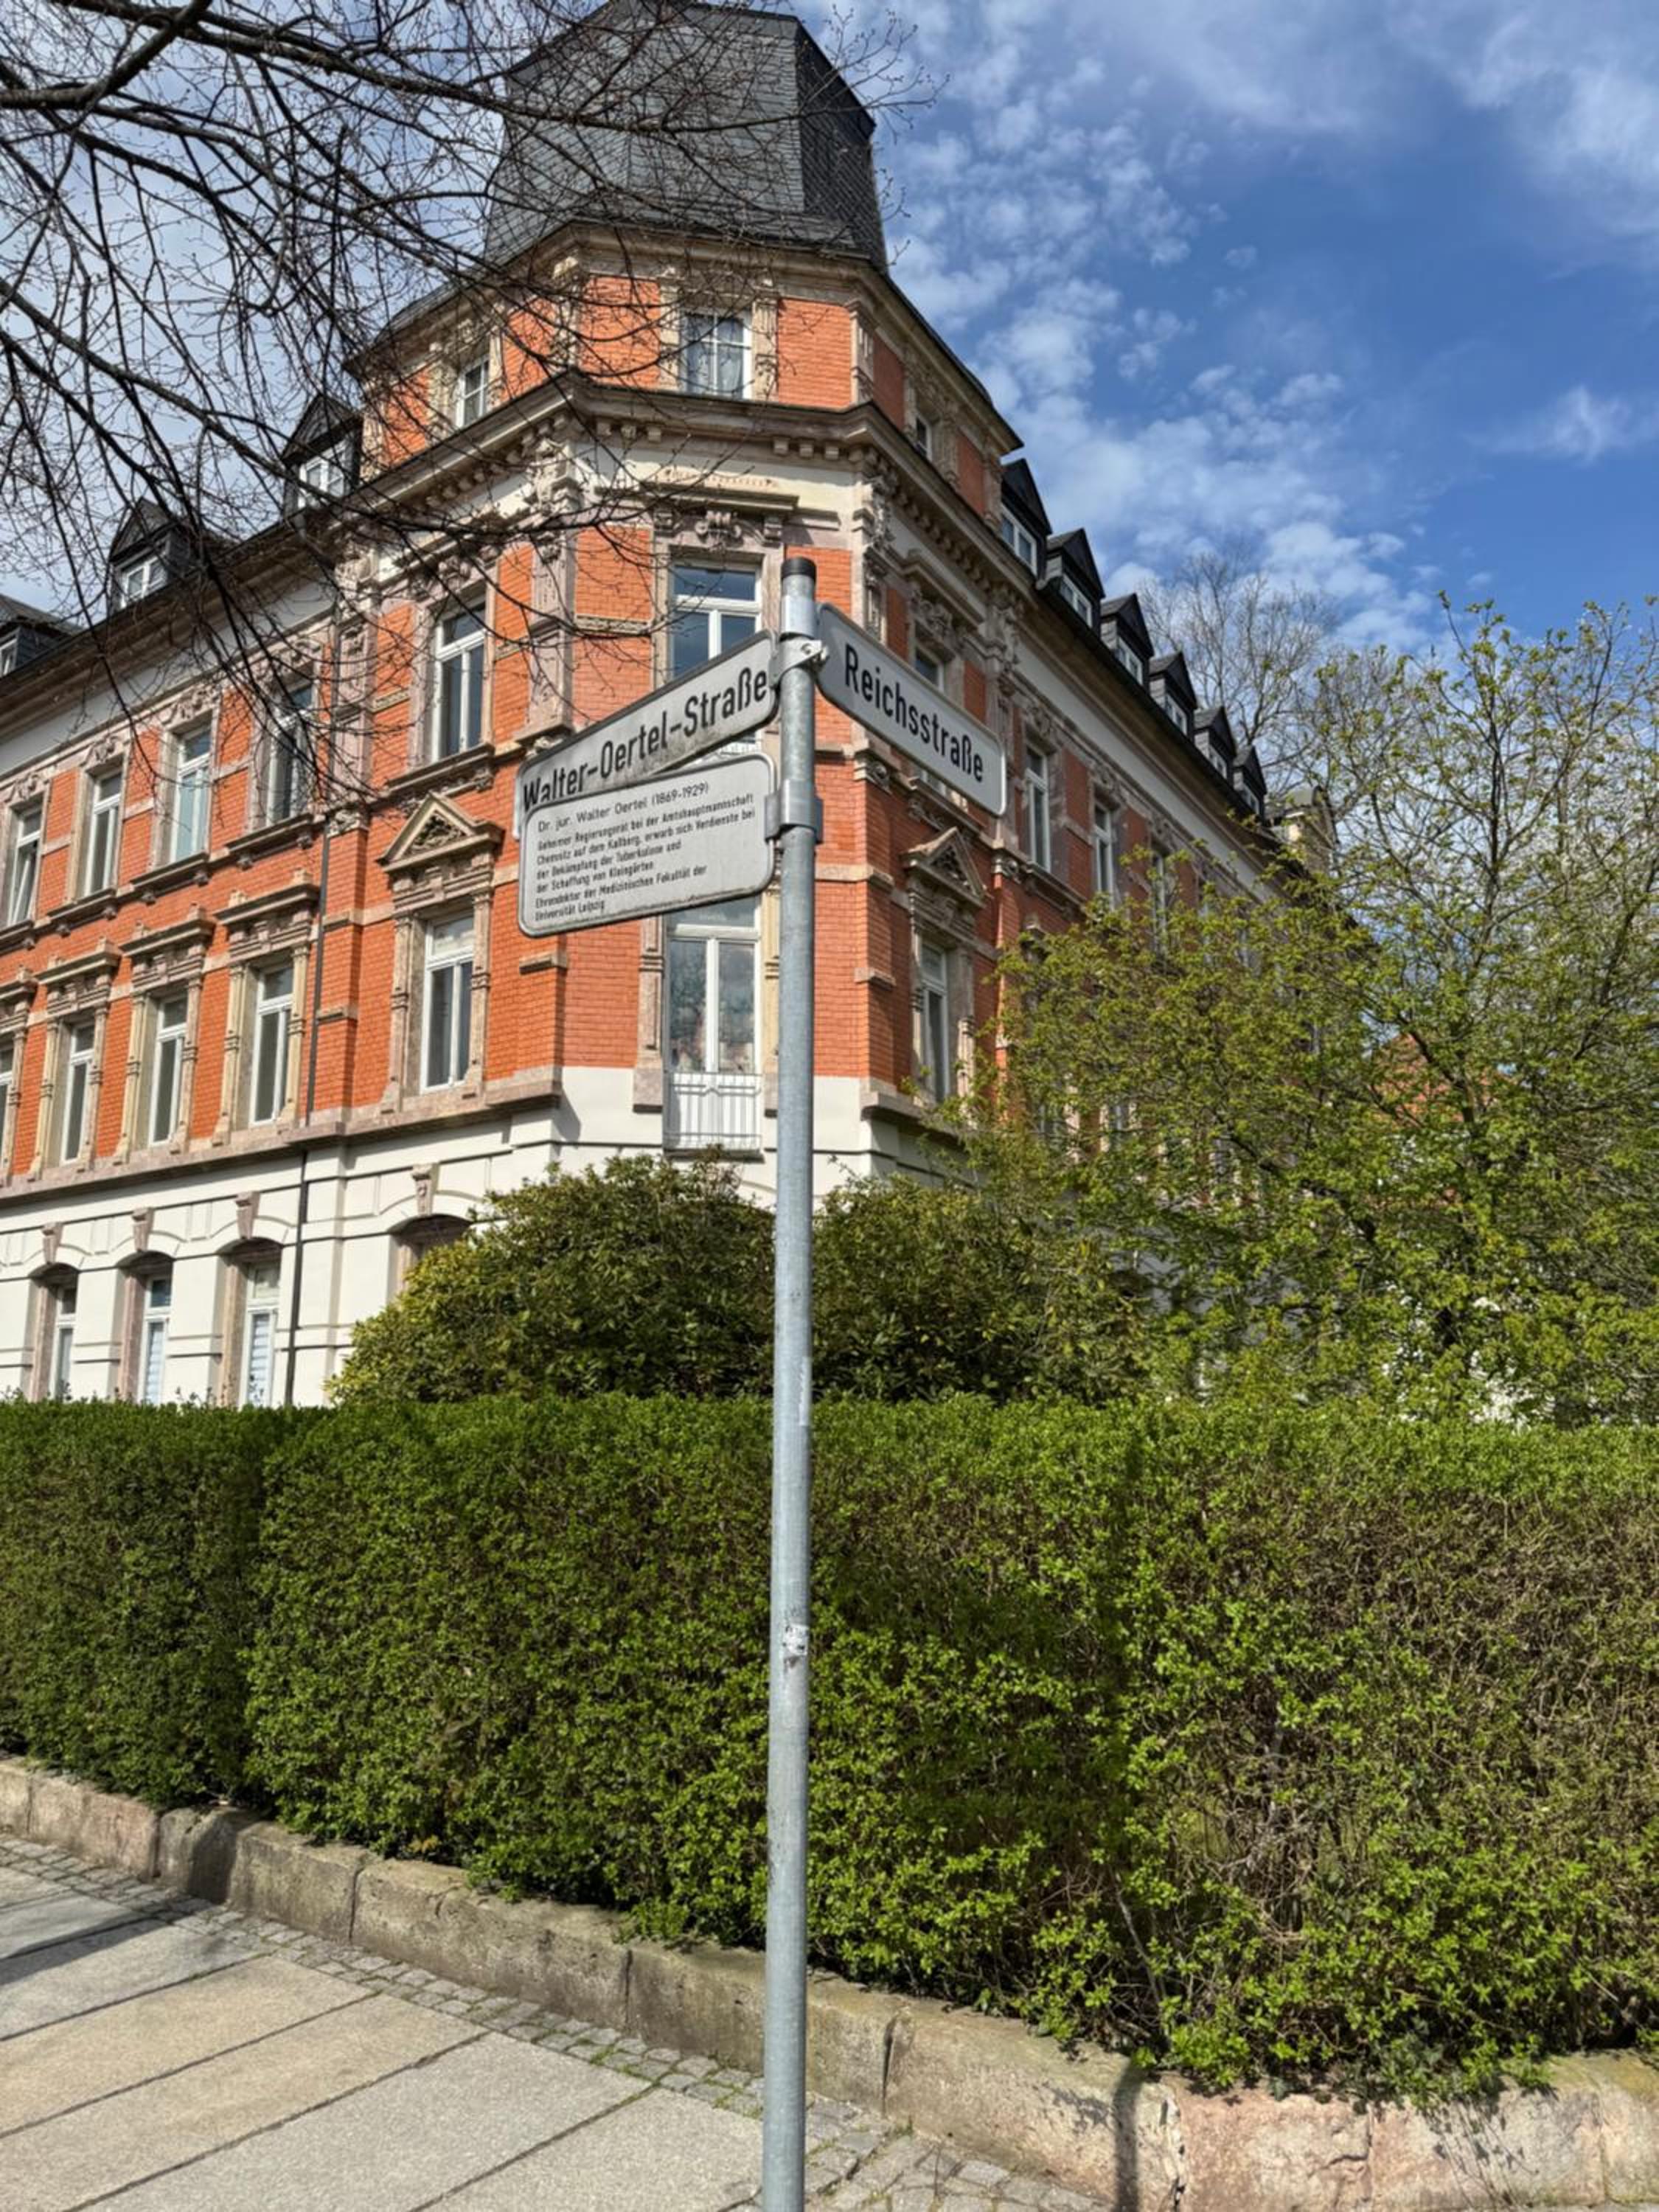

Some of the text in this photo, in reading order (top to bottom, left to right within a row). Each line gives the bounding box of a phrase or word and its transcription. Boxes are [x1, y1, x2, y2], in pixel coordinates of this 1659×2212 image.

[844, 643, 984, 782] Reichsstraße
[524, 667, 768, 811] Walter-Oertel-Straße
[538, 836, 571, 851] Geheimer
[631, 817, 644, 830] bei
[646, 815, 659, 827] der
[662, 793, 754, 822] Amtshauptmannschaft
[576, 807, 611, 823] Walter
[614, 797, 647, 815] Oertel
[651, 781, 709, 806] (1869-1929)
[537, 849, 571, 865] Chemnitz
[574, 845, 586, 857] auf
[589, 842, 605, 854] dem
[644, 827, 674, 842] erwarb
[675, 822, 693, 835] sich
[695, 813, 739, 830] Verdienste
[741, 807, 755, 821] bei
[537, 870, 549, 880] der
[600, 855, 613, 866] der
[616, 845, 663, 863] Tuberkulose
[667, 838, 681, 852] und
[537, 861, 653, 894] der Schaffung von Kleingärten
[535, 891, 581, 909] Ehrendoktor
[584, 888, 597, 899] der
[655, 867, 690, 884] Fakultät
[693, 864, 707, 877] der
[535, 900, 605, 921] Universität Leipzig
